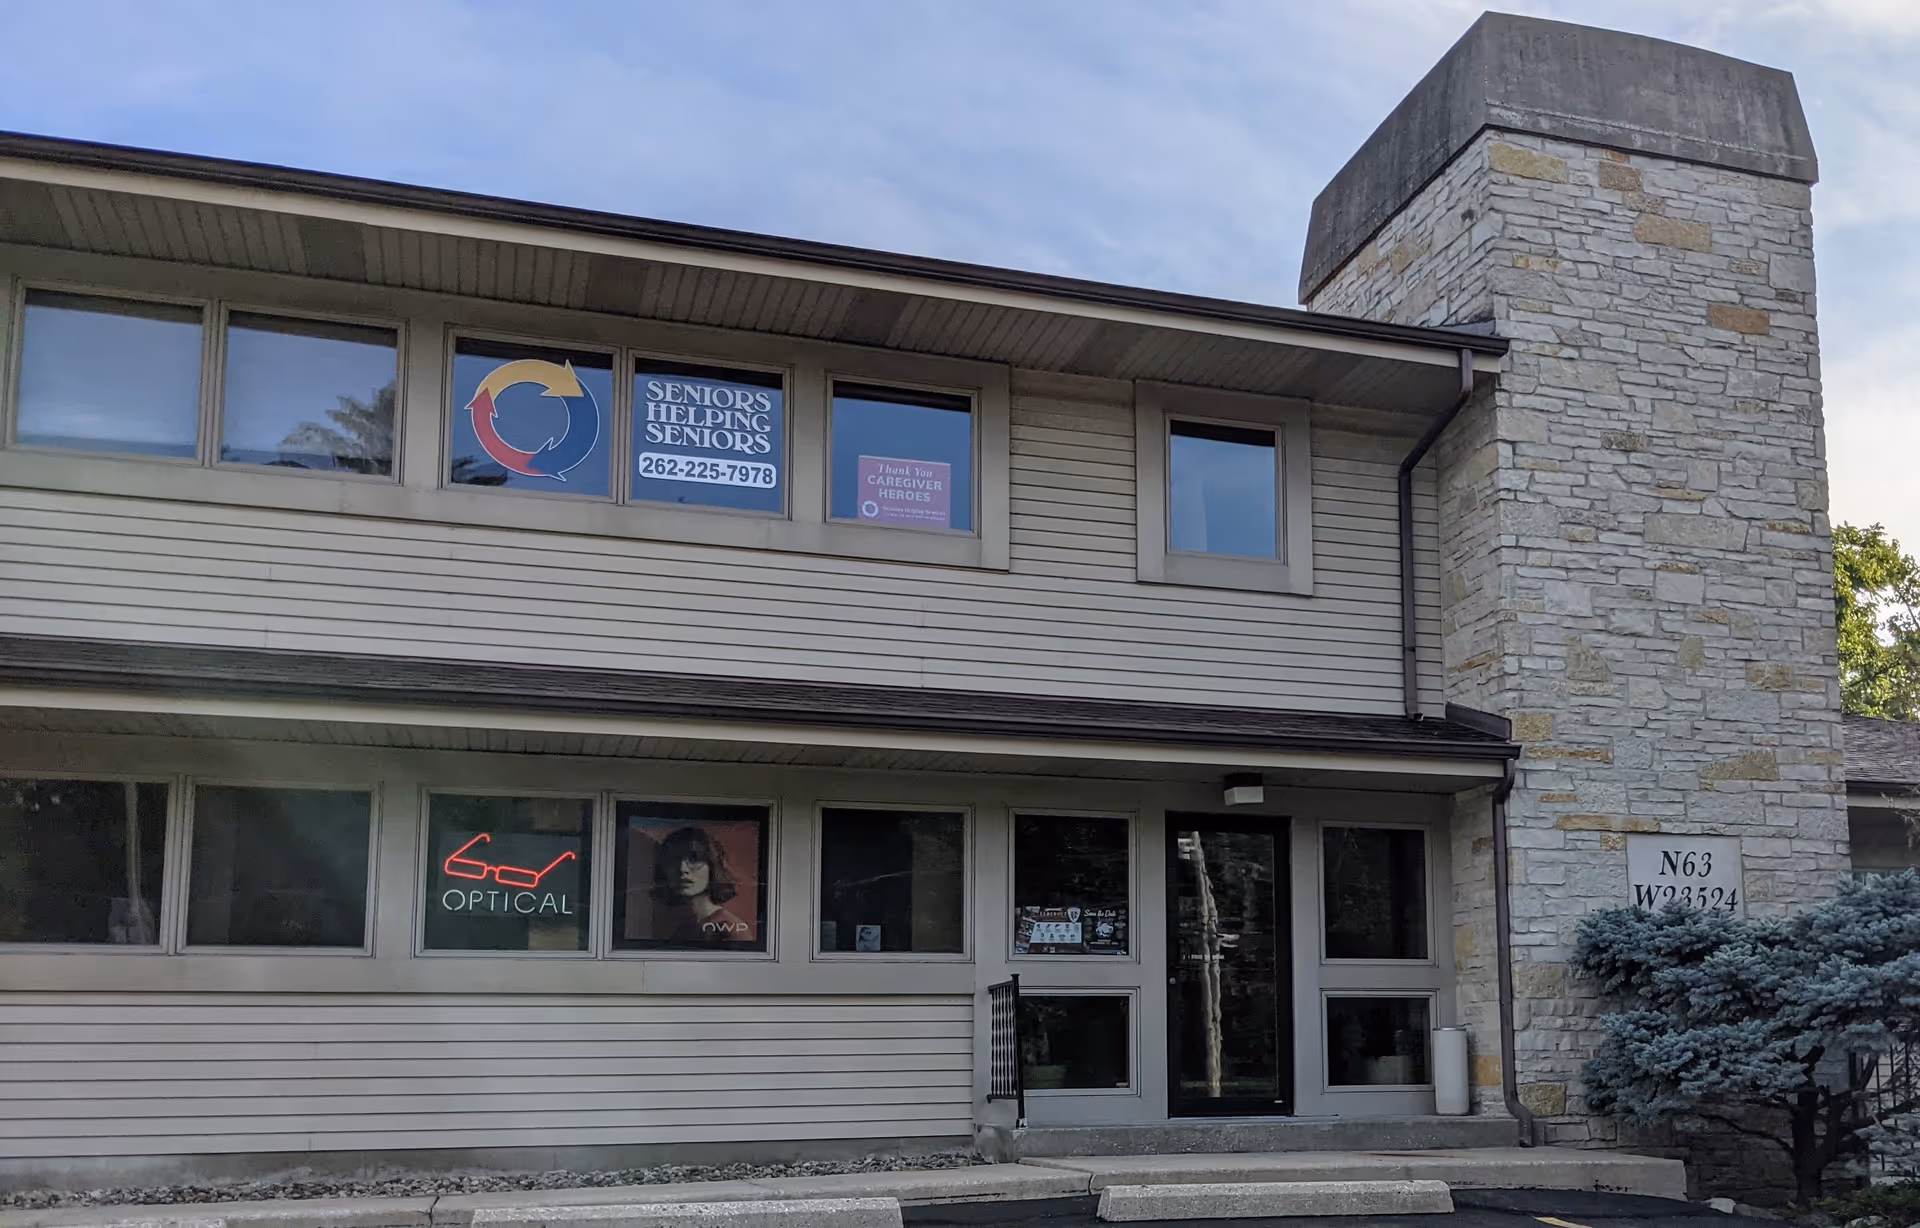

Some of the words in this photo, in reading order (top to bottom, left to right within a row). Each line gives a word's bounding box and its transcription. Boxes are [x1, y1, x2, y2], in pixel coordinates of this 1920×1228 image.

[646, 380, 772, 413] SENIORS
[646, 401, 772, 433] HELPING
[645, 423, 772, 455] SENIORS
[641, 456, 774, 485] 262-225-7978
[867, 474, 942, 491] CAREGIVER
[879, 463, 911, 476] Thank
[914, 467, 933, 478] You
[878, 488, 931, 502] HEROES
[1658, 850, 1712, 878] N63
[442, 889, 573, 915] OPTICAL
[1633, 884, 1739, 912] W23524
